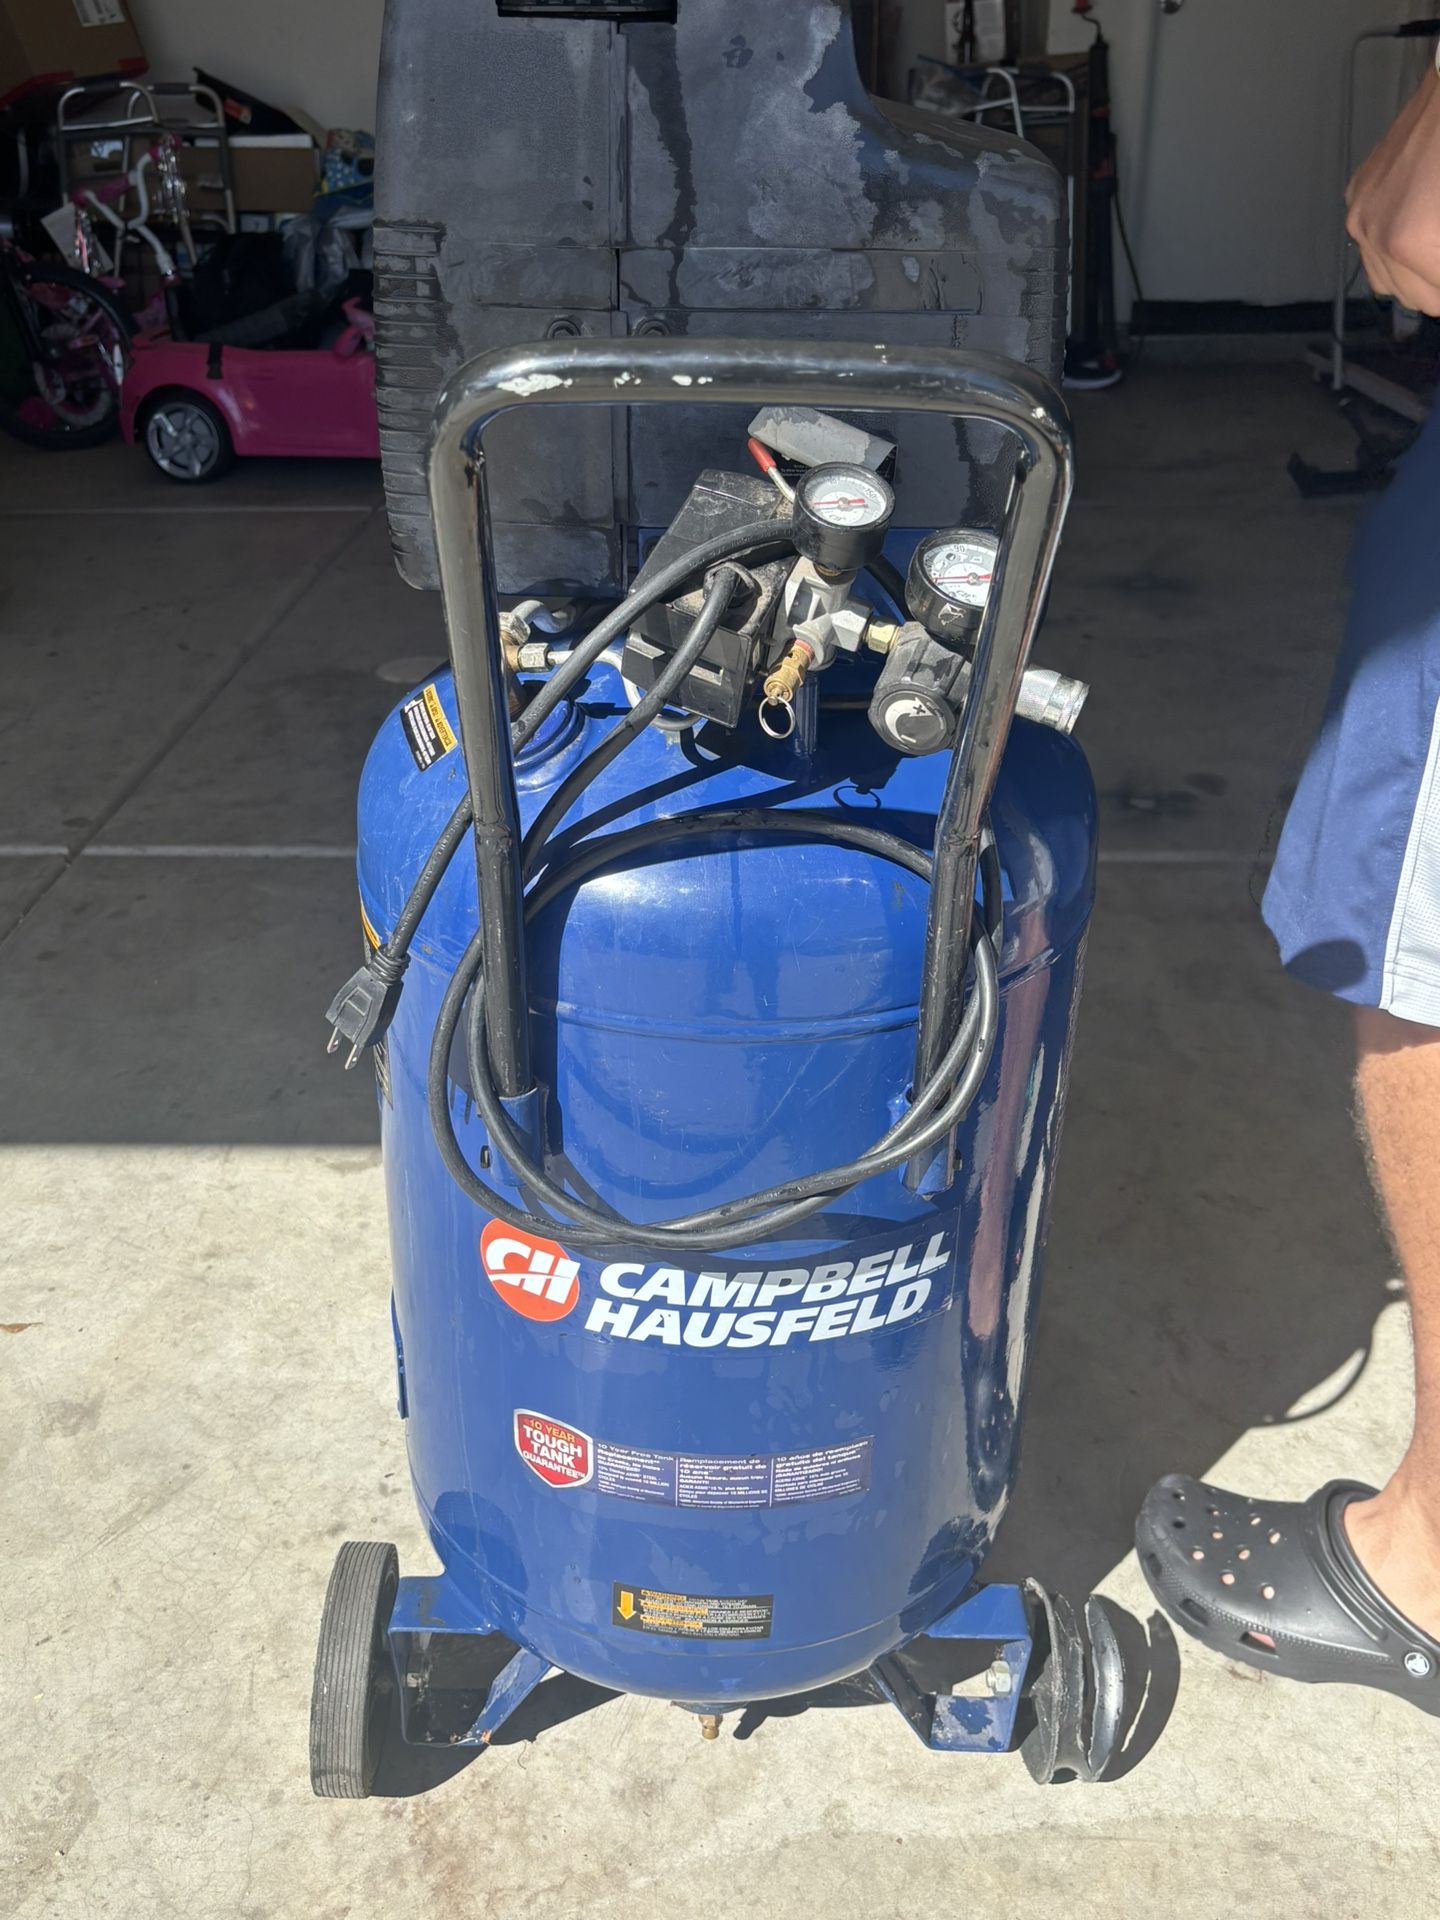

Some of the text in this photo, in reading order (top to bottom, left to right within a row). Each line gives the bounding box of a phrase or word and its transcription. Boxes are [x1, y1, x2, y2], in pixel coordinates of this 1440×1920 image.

[599, 1232, 952, 1308] CAMPBELL
[585, 1278, 932, 1347] HAUSFELD
[523, 1425, 582, 1458] TOUGH
[529, 1419, 575, 1443] 10 YEAR
[531, 1440, 576, 1468] TANK
